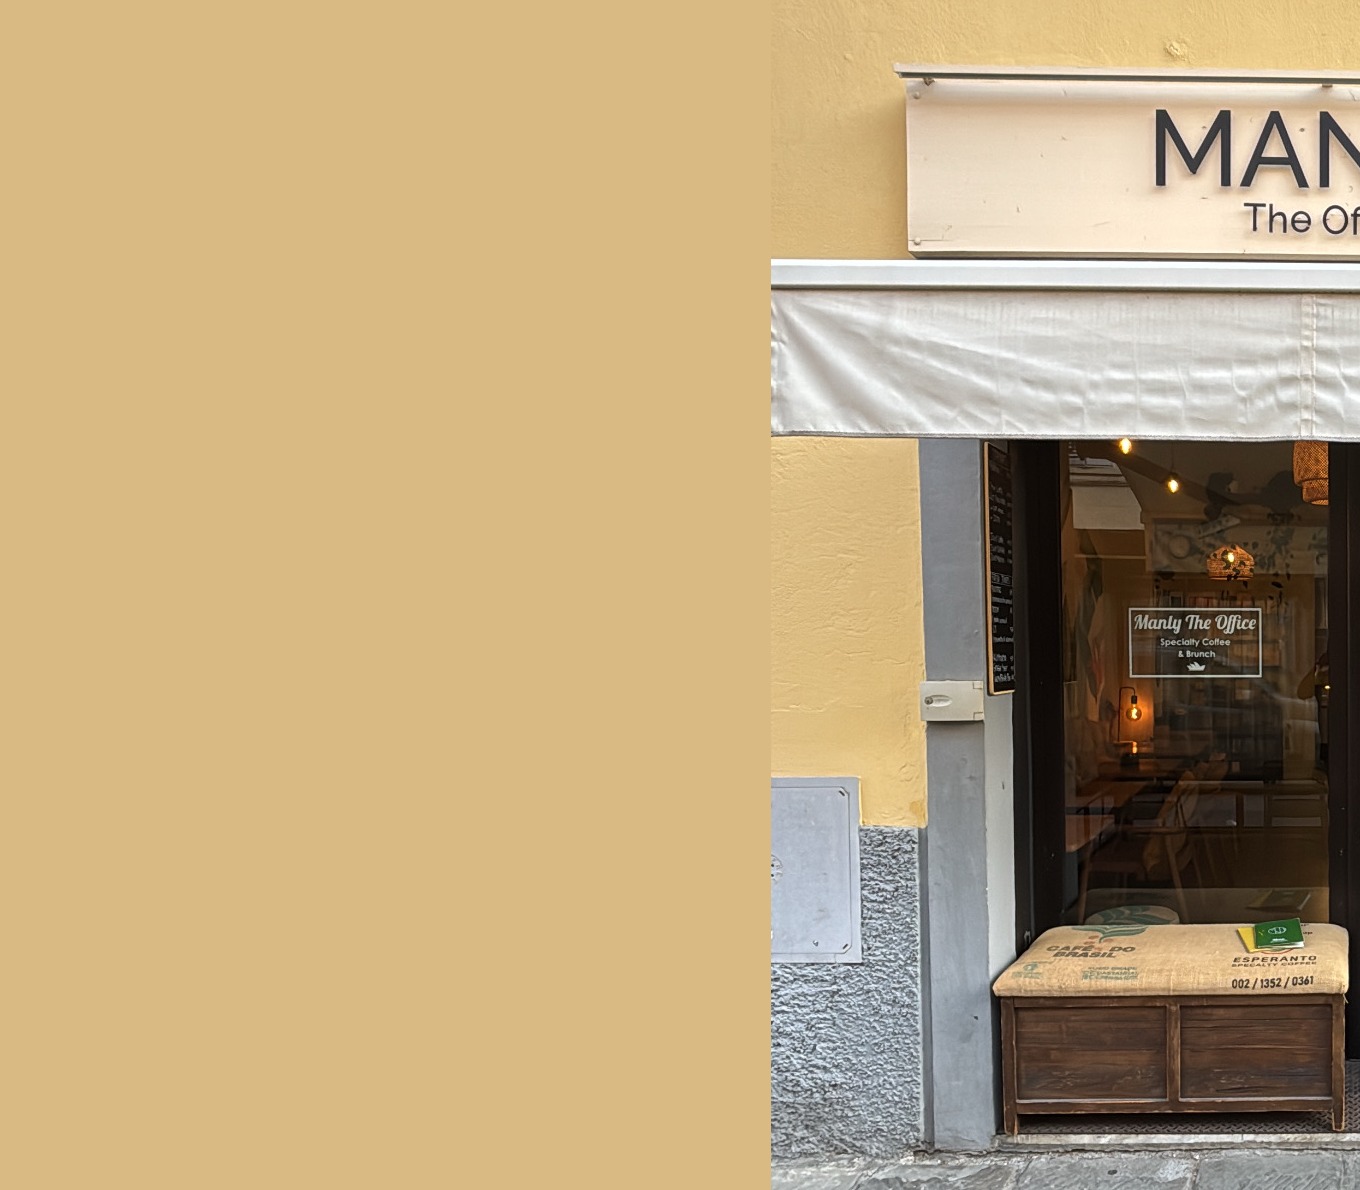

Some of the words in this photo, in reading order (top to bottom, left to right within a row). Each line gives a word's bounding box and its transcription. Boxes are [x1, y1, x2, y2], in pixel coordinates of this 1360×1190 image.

[1244, 202, 1312, 233] The
[1134, 614, 1182, 634] Manly
[1185, 614, 1212, 630] The
[1215, 614, 1257, 634] Office
[1160, 638, 1199, 647] Specialty
[1202, 638, 1231, 646] Coffee
[1178, 650, 1184, 658] &
[1186, 650, 1216, 658] Brunch
[1046, 944, 1094, 952] CAFÉ
[1233, 955, 1317, 963] ESPERANTO
[1231, 979, 1250, 989] 002
[1252, 978, 1258, 990] /
[1260, 977, 1282, 988] 1352
[1283, 976, 1290, 989] /
[1292, 975, 1314, 987] 0361
